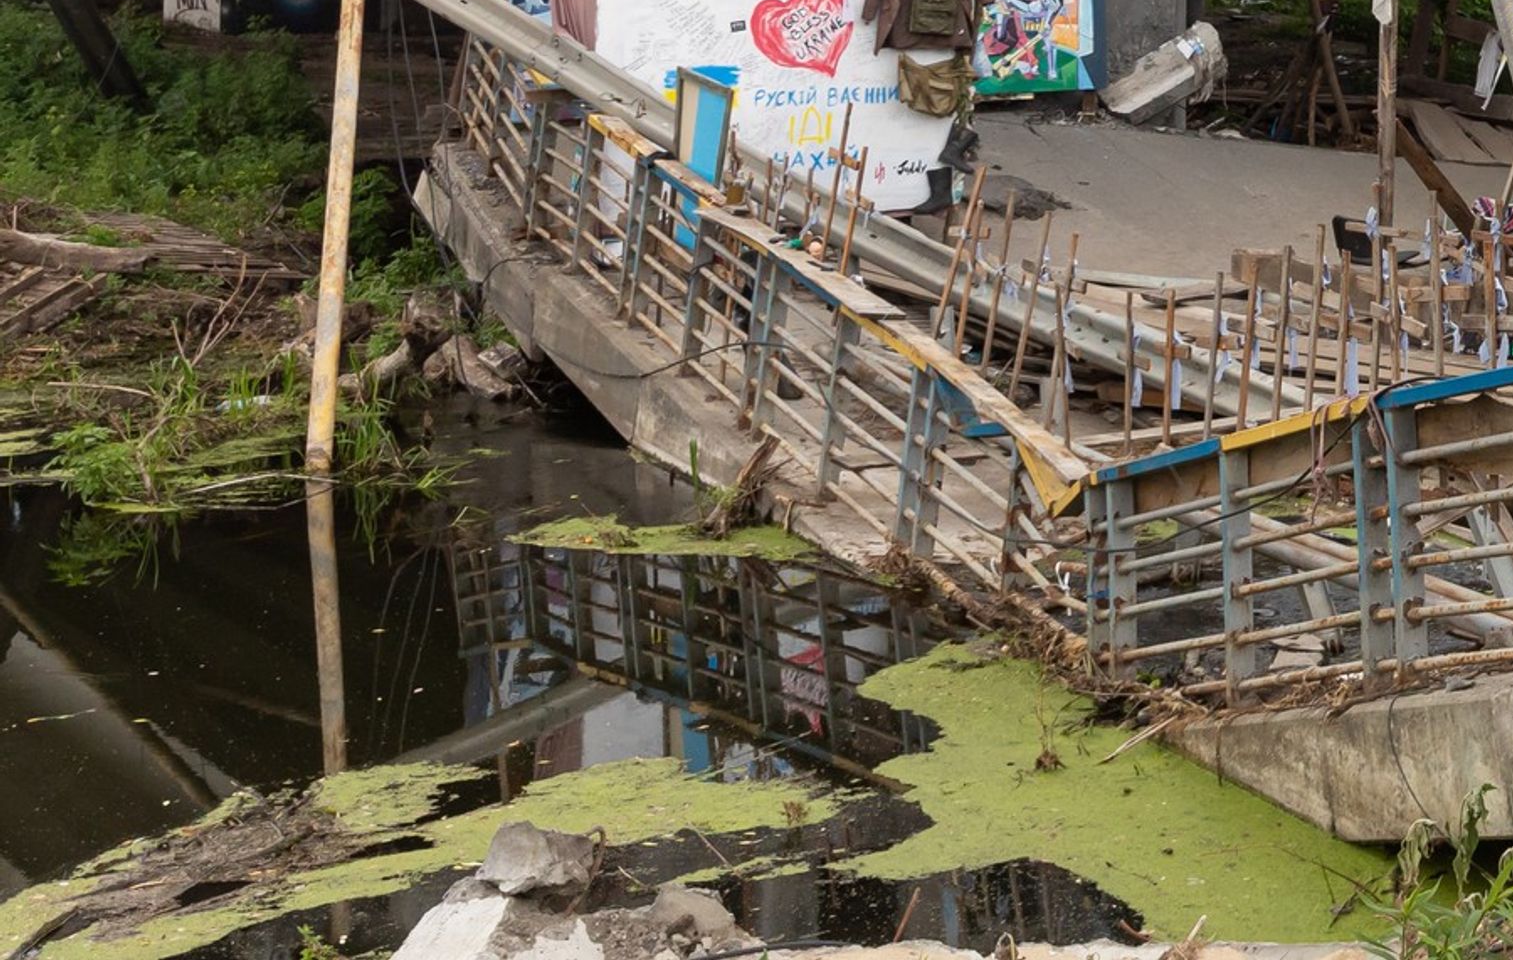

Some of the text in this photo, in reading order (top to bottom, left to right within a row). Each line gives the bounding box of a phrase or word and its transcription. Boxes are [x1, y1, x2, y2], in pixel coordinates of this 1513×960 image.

[789, 11, 830, 41] BLESS
[795, 15, 848, 60] UKRAINE
[754, 85, 817, 107] РУСКІЙ
[788, 105, 834, 146] ІДІ
